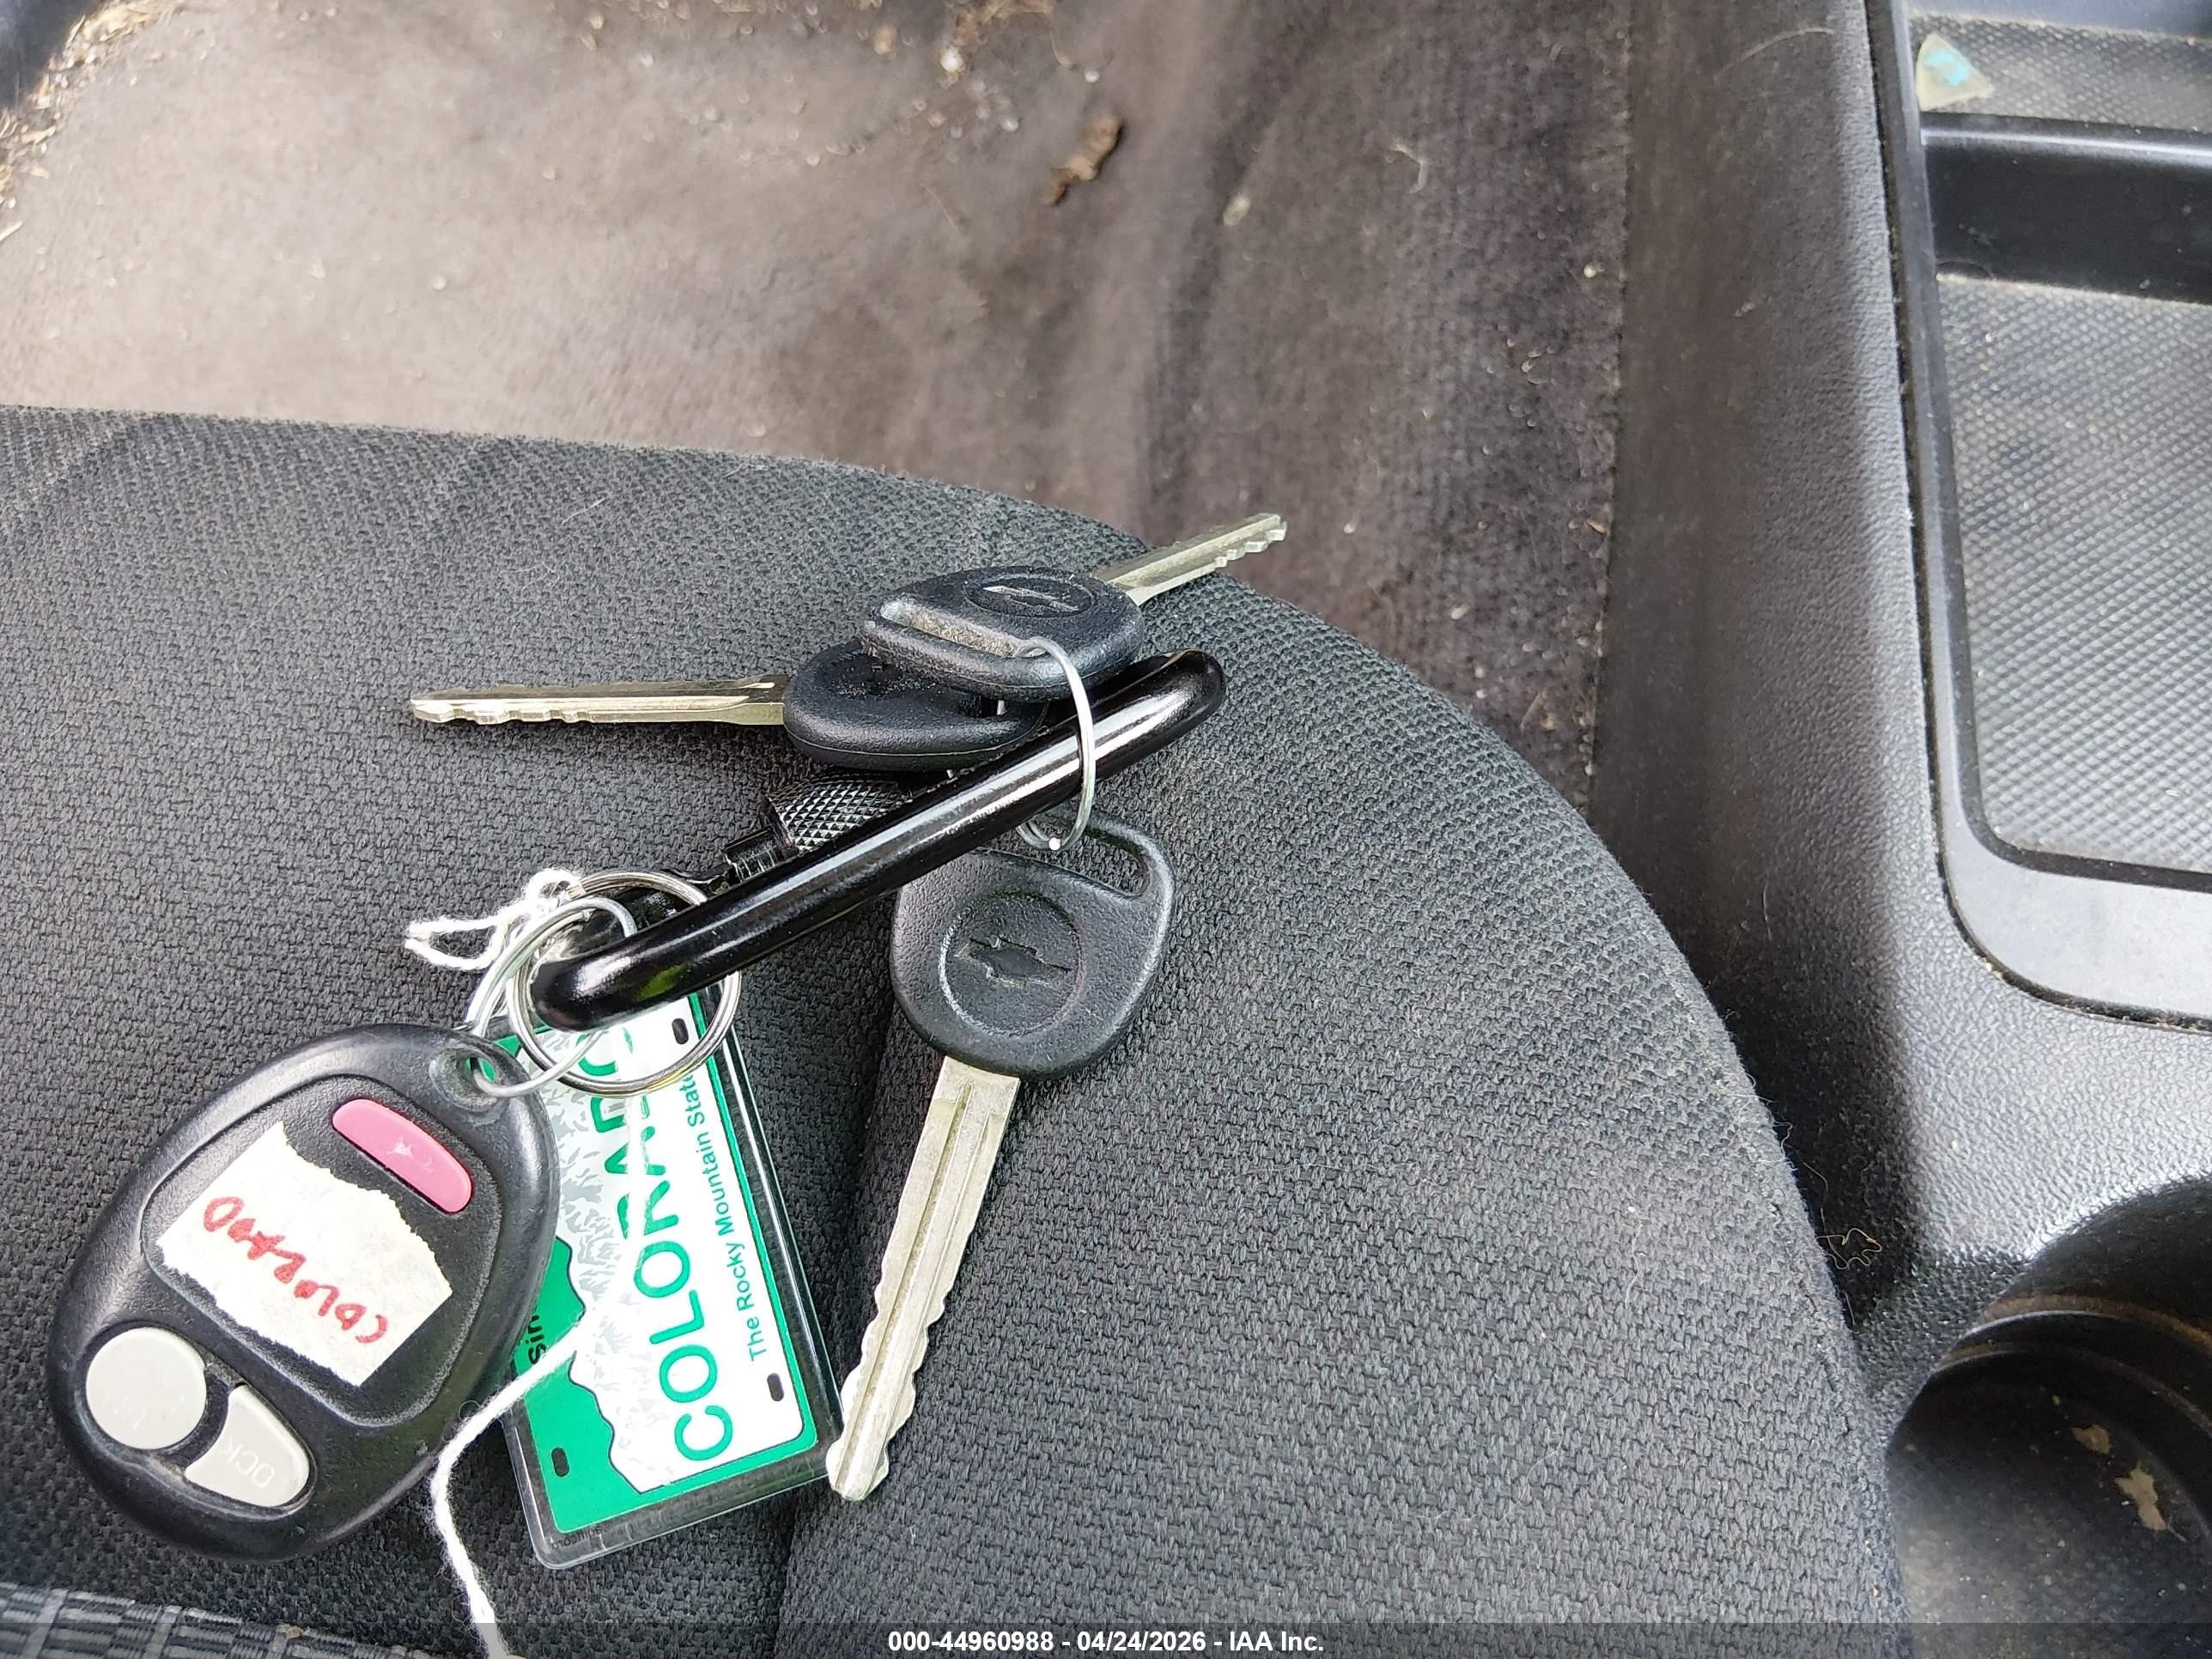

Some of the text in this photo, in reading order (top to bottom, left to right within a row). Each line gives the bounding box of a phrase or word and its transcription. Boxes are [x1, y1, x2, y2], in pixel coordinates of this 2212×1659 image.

[695, 1131, 734, 1237] Mountain
[726, 1242, 755, 1311] Rocky
[525, 1306, 547, 1364] Sin
[746, 1316, 768, 1362] The
